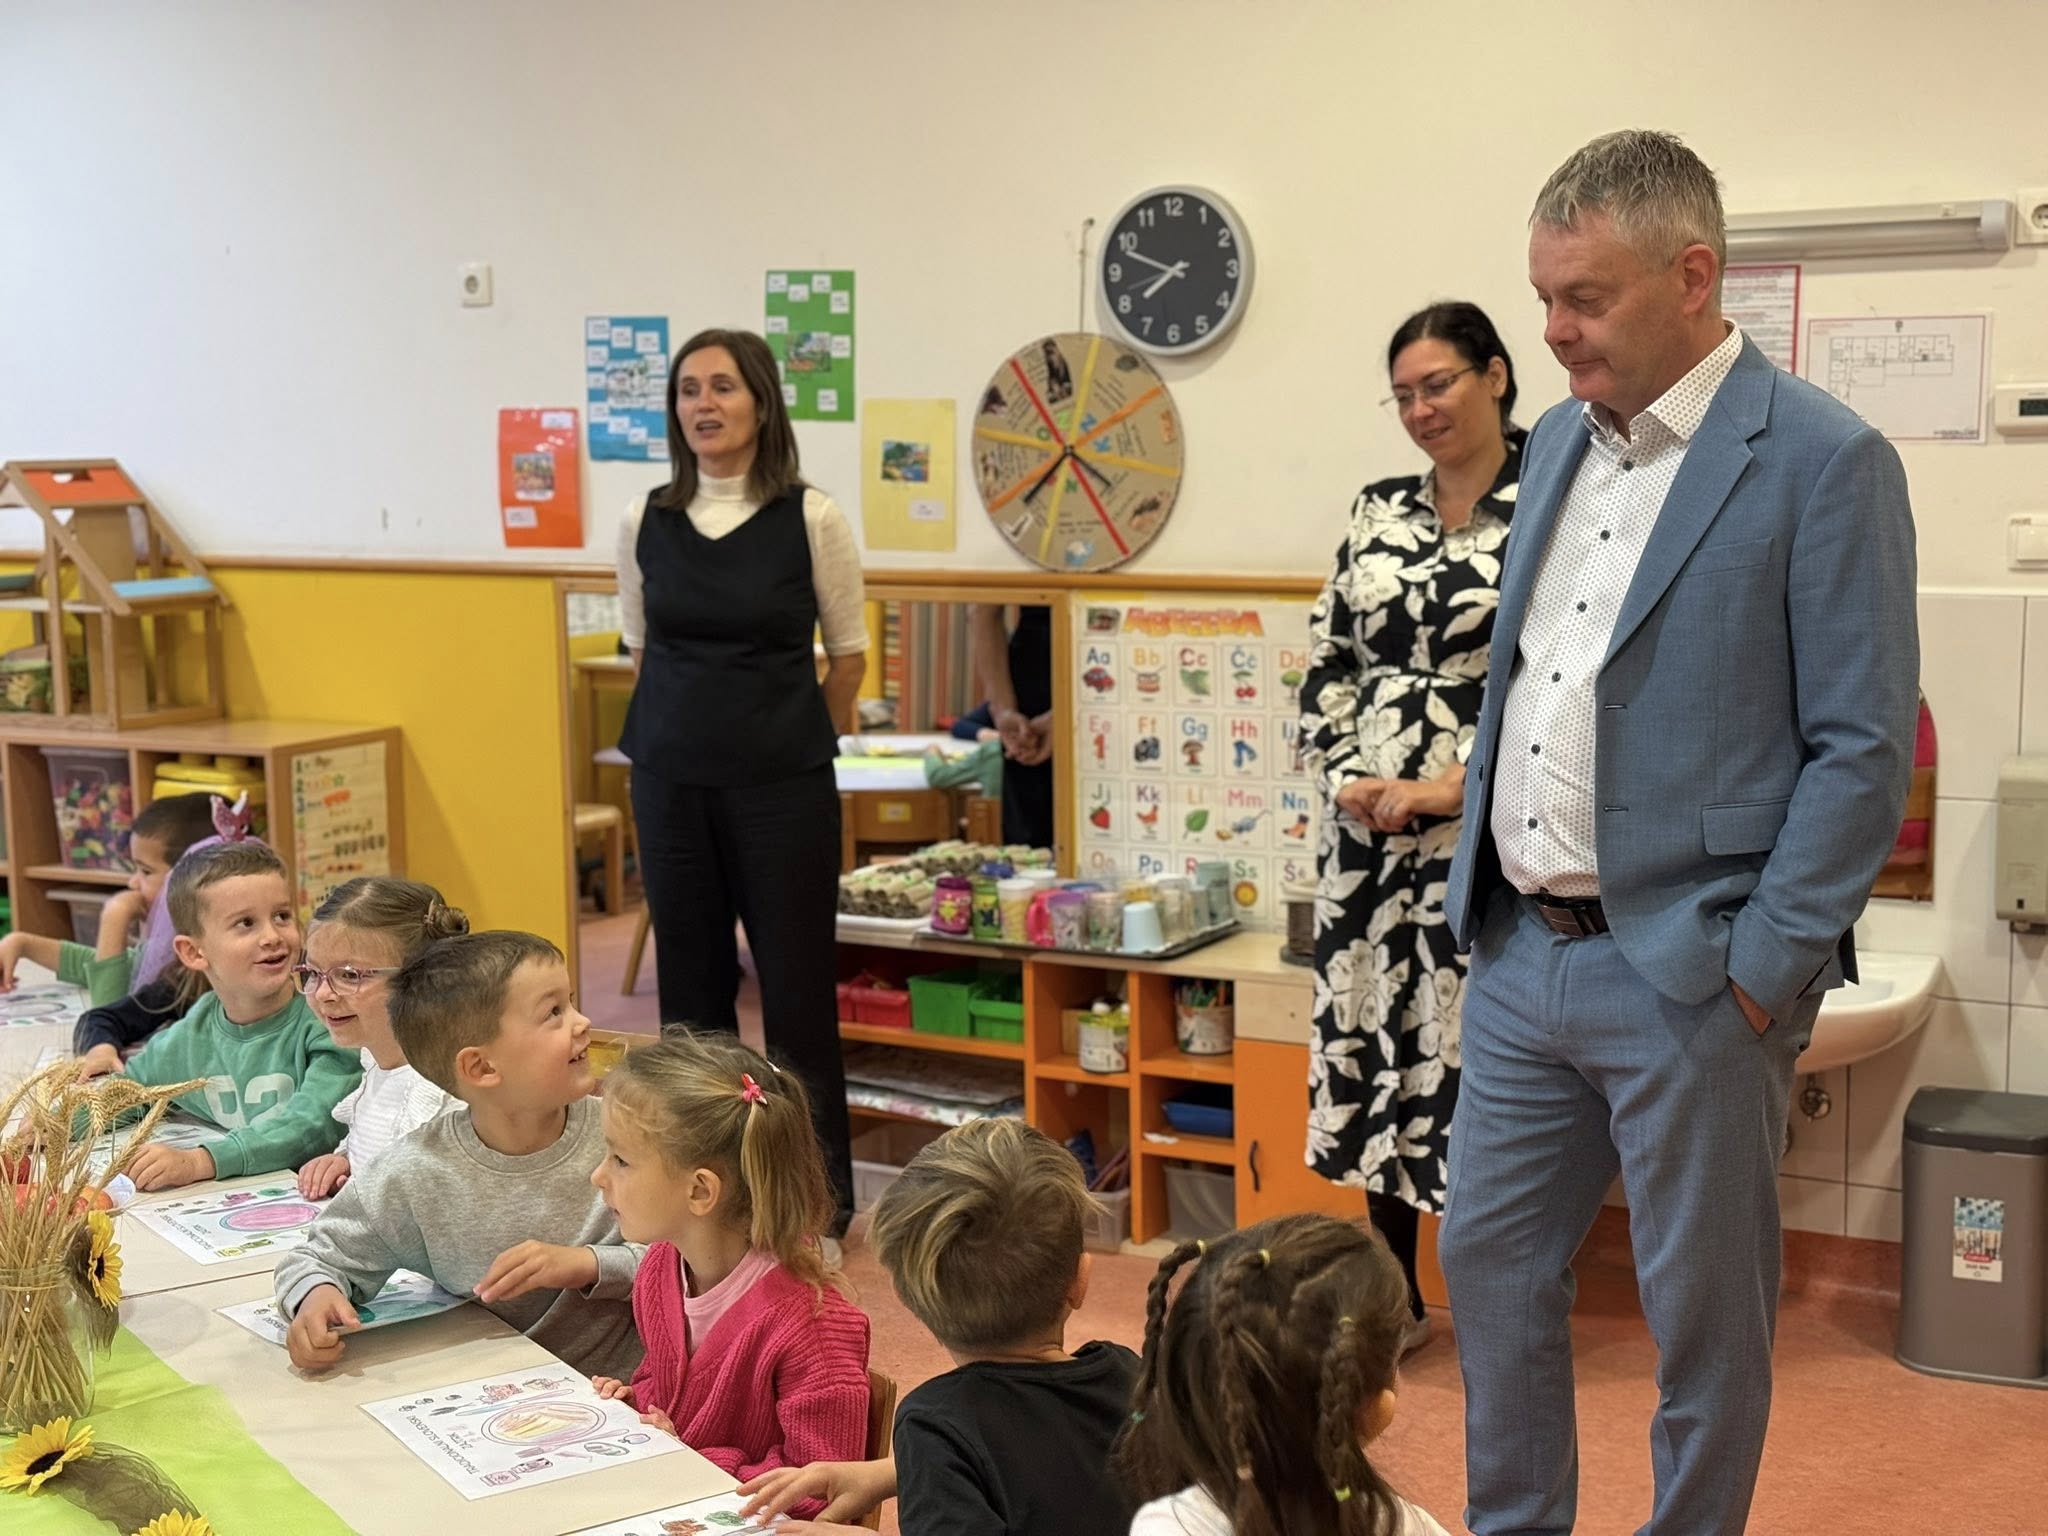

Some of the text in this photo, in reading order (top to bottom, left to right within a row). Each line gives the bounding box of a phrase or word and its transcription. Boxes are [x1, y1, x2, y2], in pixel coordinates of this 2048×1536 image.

[1164, 197, 1184, 216] 12
[1199, 205, 1207, 224] 1
[1137, 207, 1155, 227] 11
[1118, 231, 1138, 251] 10
[1218, 228, 1231, 247] 2
[1109, 262, 1122, 282] 9
[1226, 259, 1238, 278] 3
[1118, 294, 1132, 314] 8
[1216, 290, 1229, 309] 4
[1142, 316, 1154, 336] 7
[1167, 324, 1180, 343] 6
[1195, 315, 1209, 335] 5
[1087, 647, 1111, 665] Aa
[1134, 648, 1160, 666] Bb
[1180, 648, 1207, 666] Cc
[1182, 717, 1208, 740] Gg
[1231, 720, 1257, 737] Hh
[1137, 786, 1160, 802] Kk
[1228, 790, 1263, 807] Mm
[1282, 792, 1308, 809] Nn
[1139, 855, 1163, 874] Pp
[1235, 860, 1257, 879] Ss
